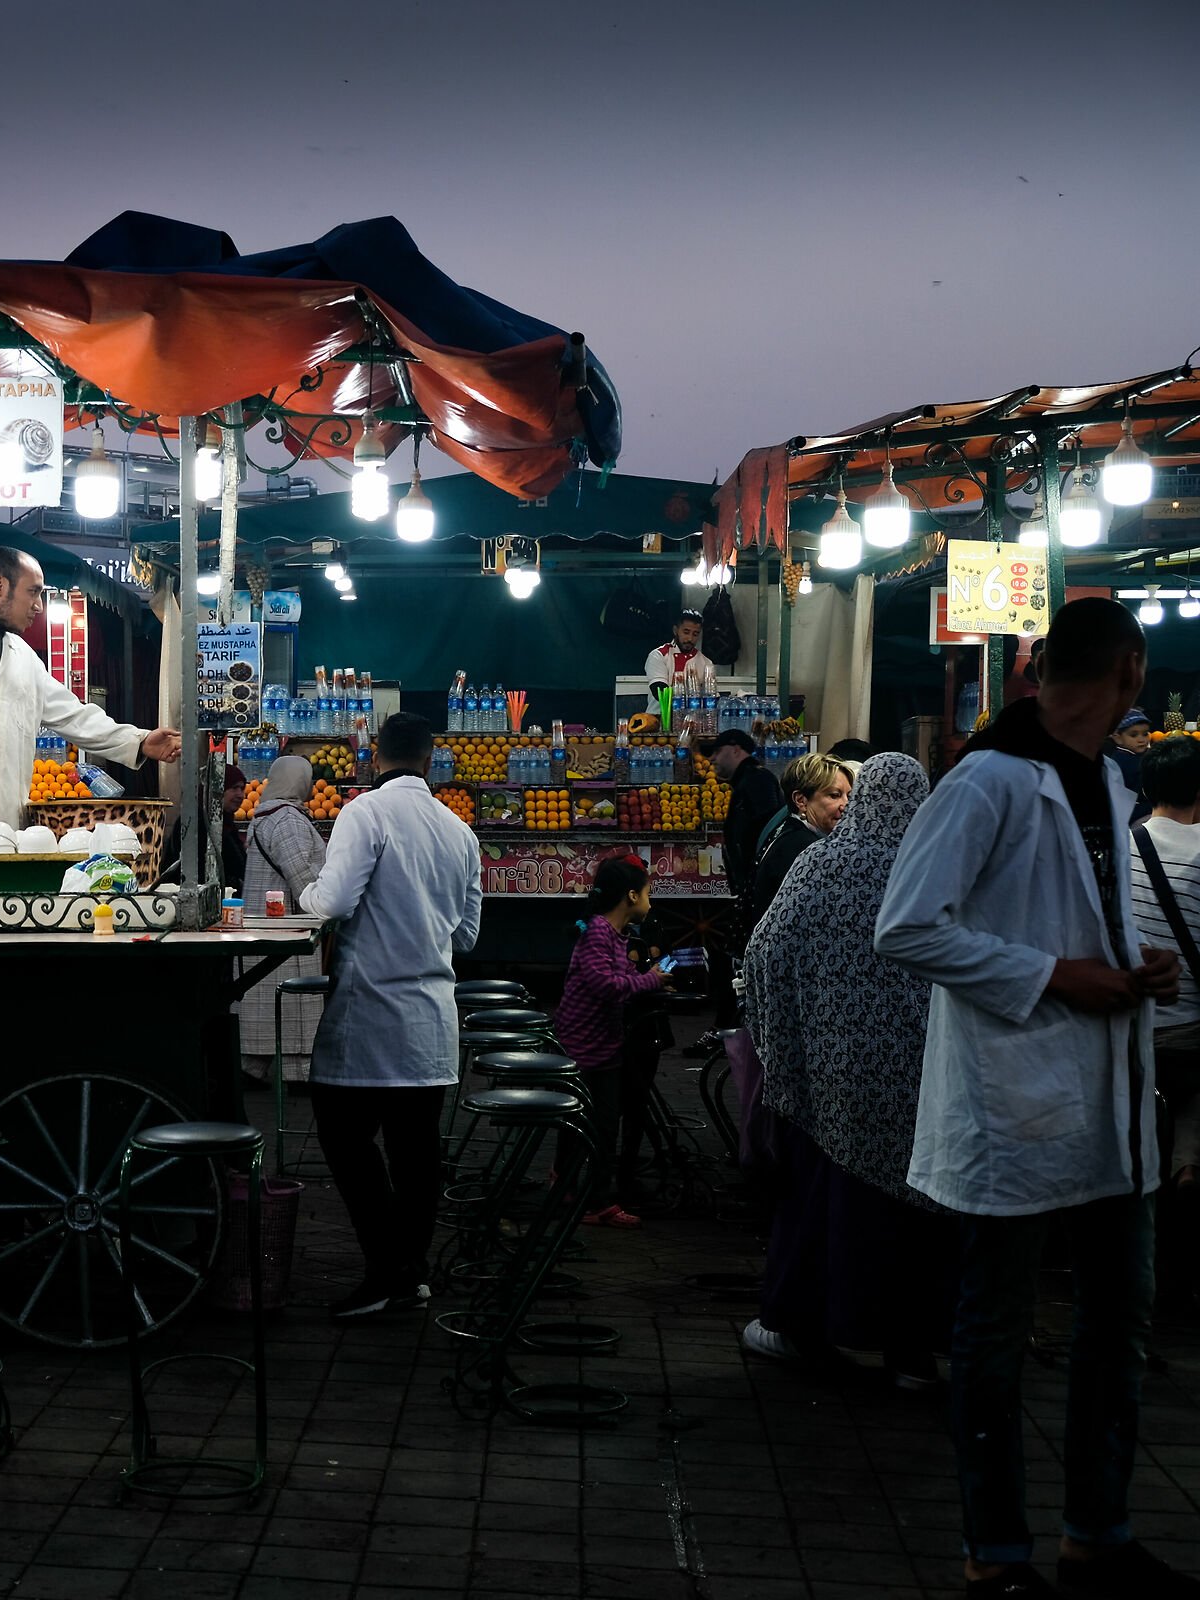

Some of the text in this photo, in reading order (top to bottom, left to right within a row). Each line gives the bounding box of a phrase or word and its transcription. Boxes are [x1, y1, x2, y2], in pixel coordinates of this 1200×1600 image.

[982, 565, 1009, 611] 6
[211, 640, 257, 649] MUSTAPHA
[205, 651, 241, 661] TARIF
[207, 669, 224, 679] DH
[207, 684, 224, 694] DH
[207, 698, 224, 708] DH
